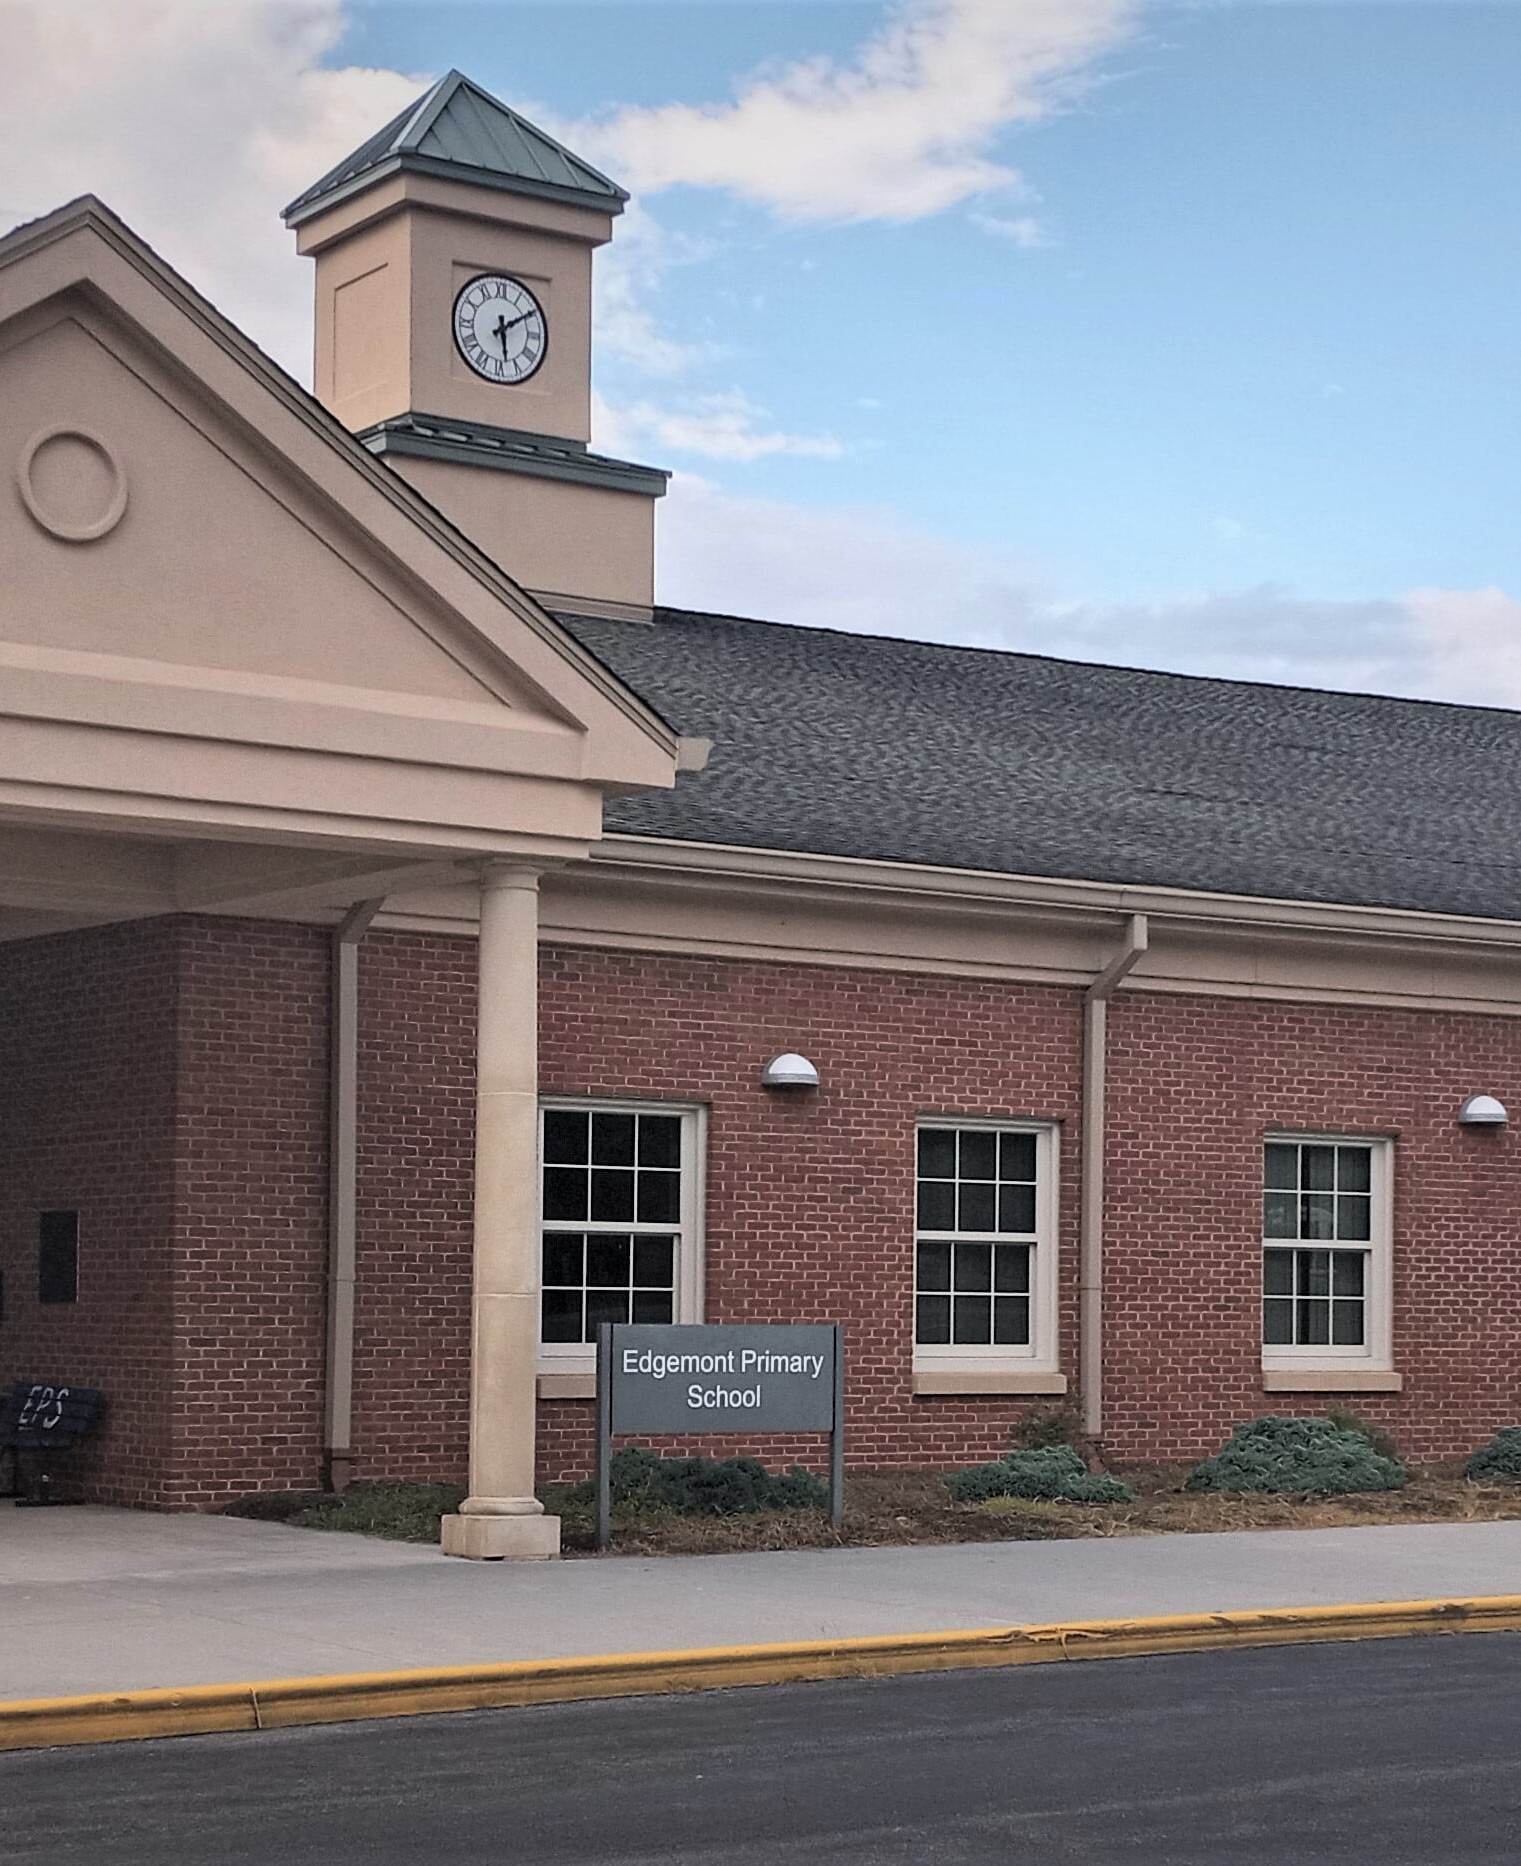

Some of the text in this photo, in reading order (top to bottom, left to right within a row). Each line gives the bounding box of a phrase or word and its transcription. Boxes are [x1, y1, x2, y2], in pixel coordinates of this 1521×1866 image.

[623, 1349, 824, 1379] Edgemont Primary
[18, 1385, 69, 1430] EPS
[687, 1384, 761, 1408] School
